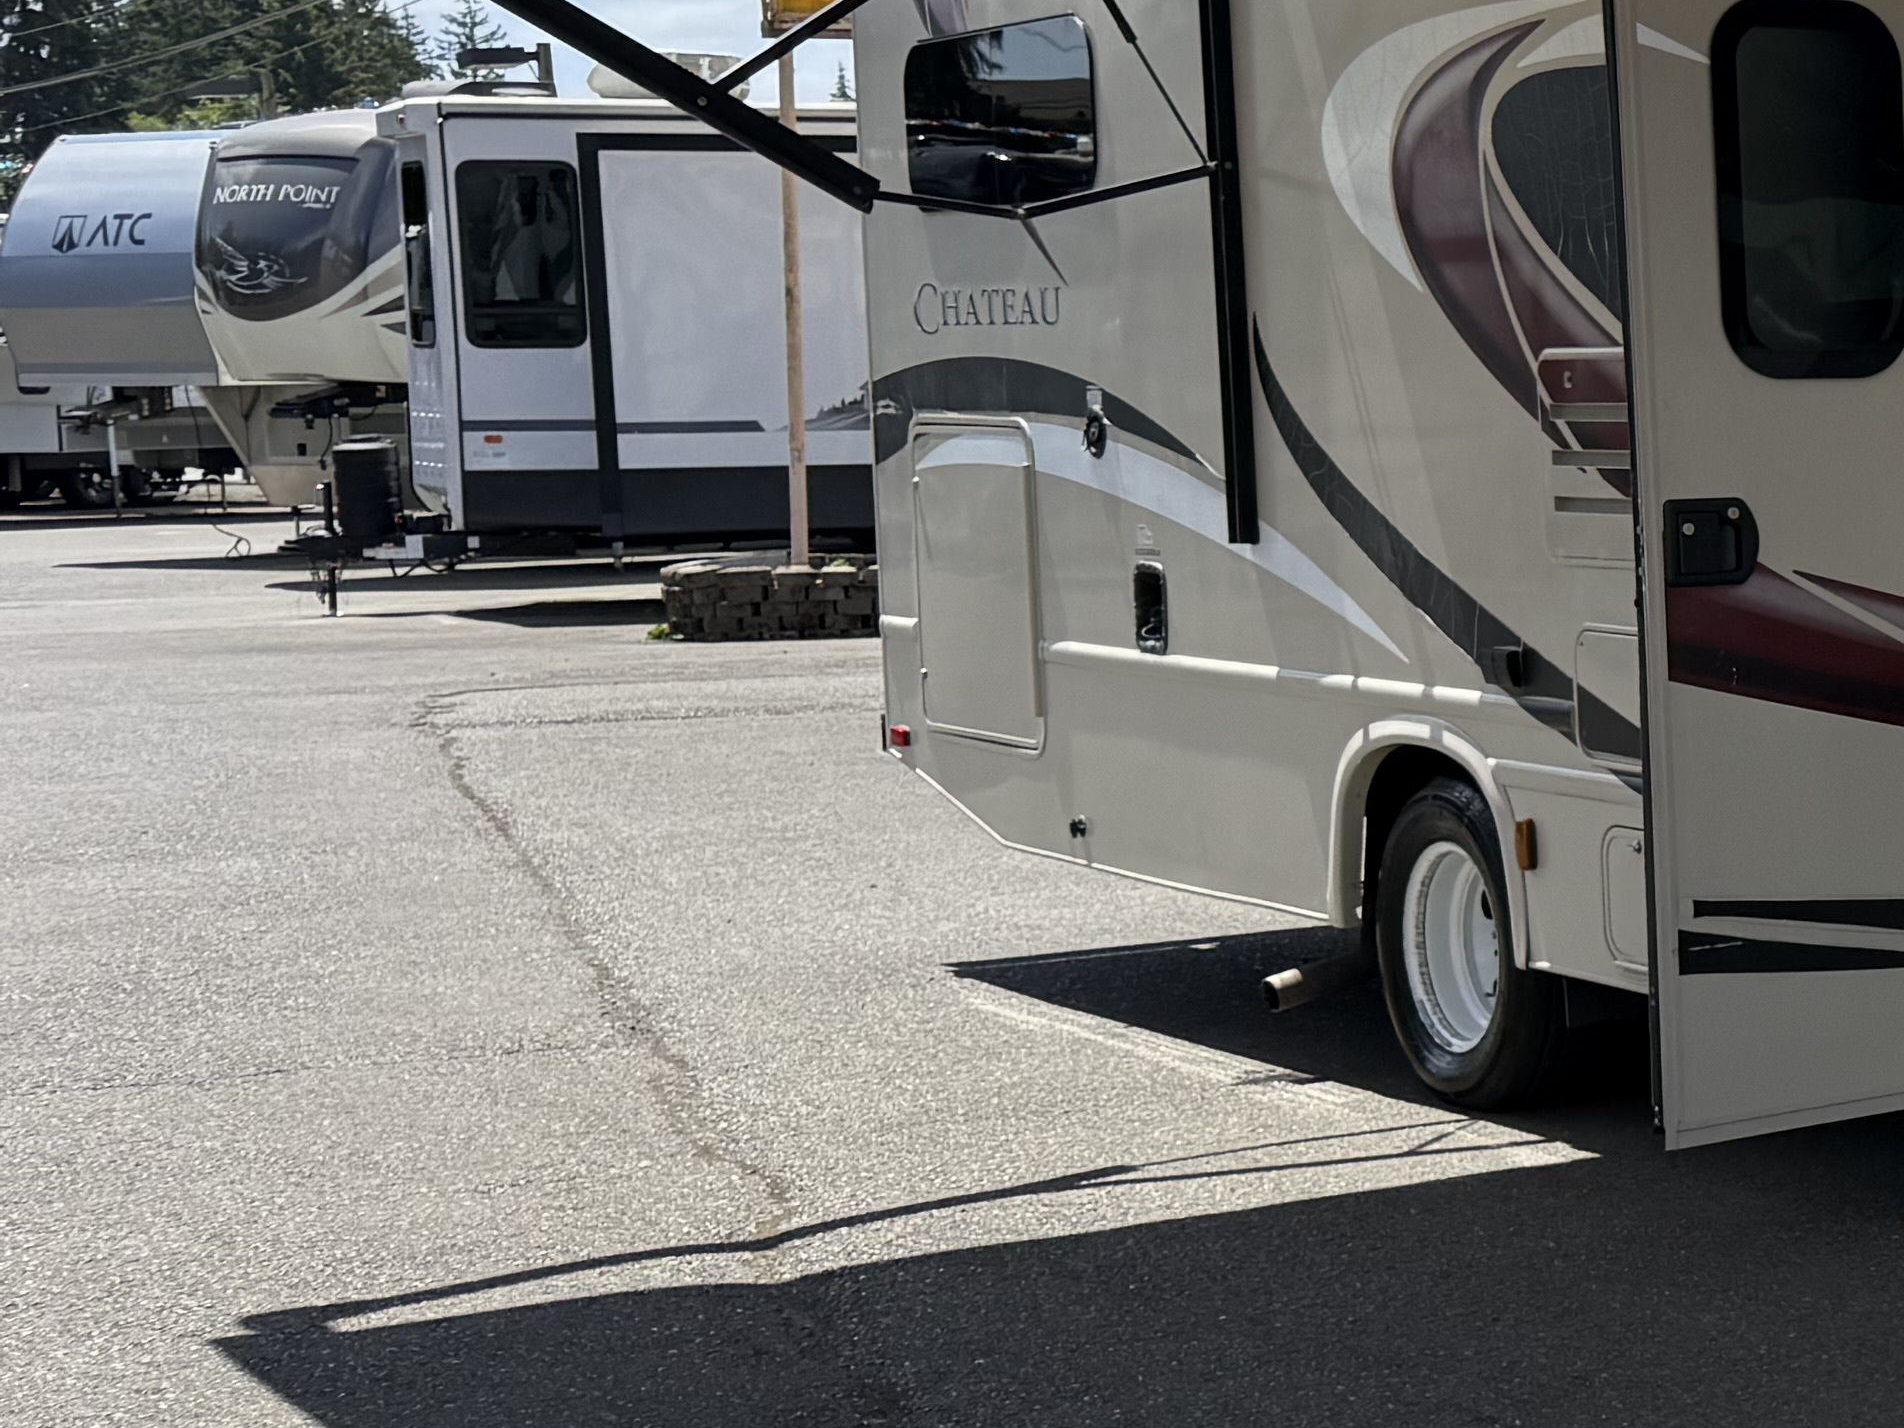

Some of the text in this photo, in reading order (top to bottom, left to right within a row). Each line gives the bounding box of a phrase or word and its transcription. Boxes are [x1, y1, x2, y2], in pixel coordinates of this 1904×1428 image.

[213, 183, 340, 204] NORTH POINT
[86, 212, 152, 247] ATC
[914, 283, 1063, 335] CHATEAU
